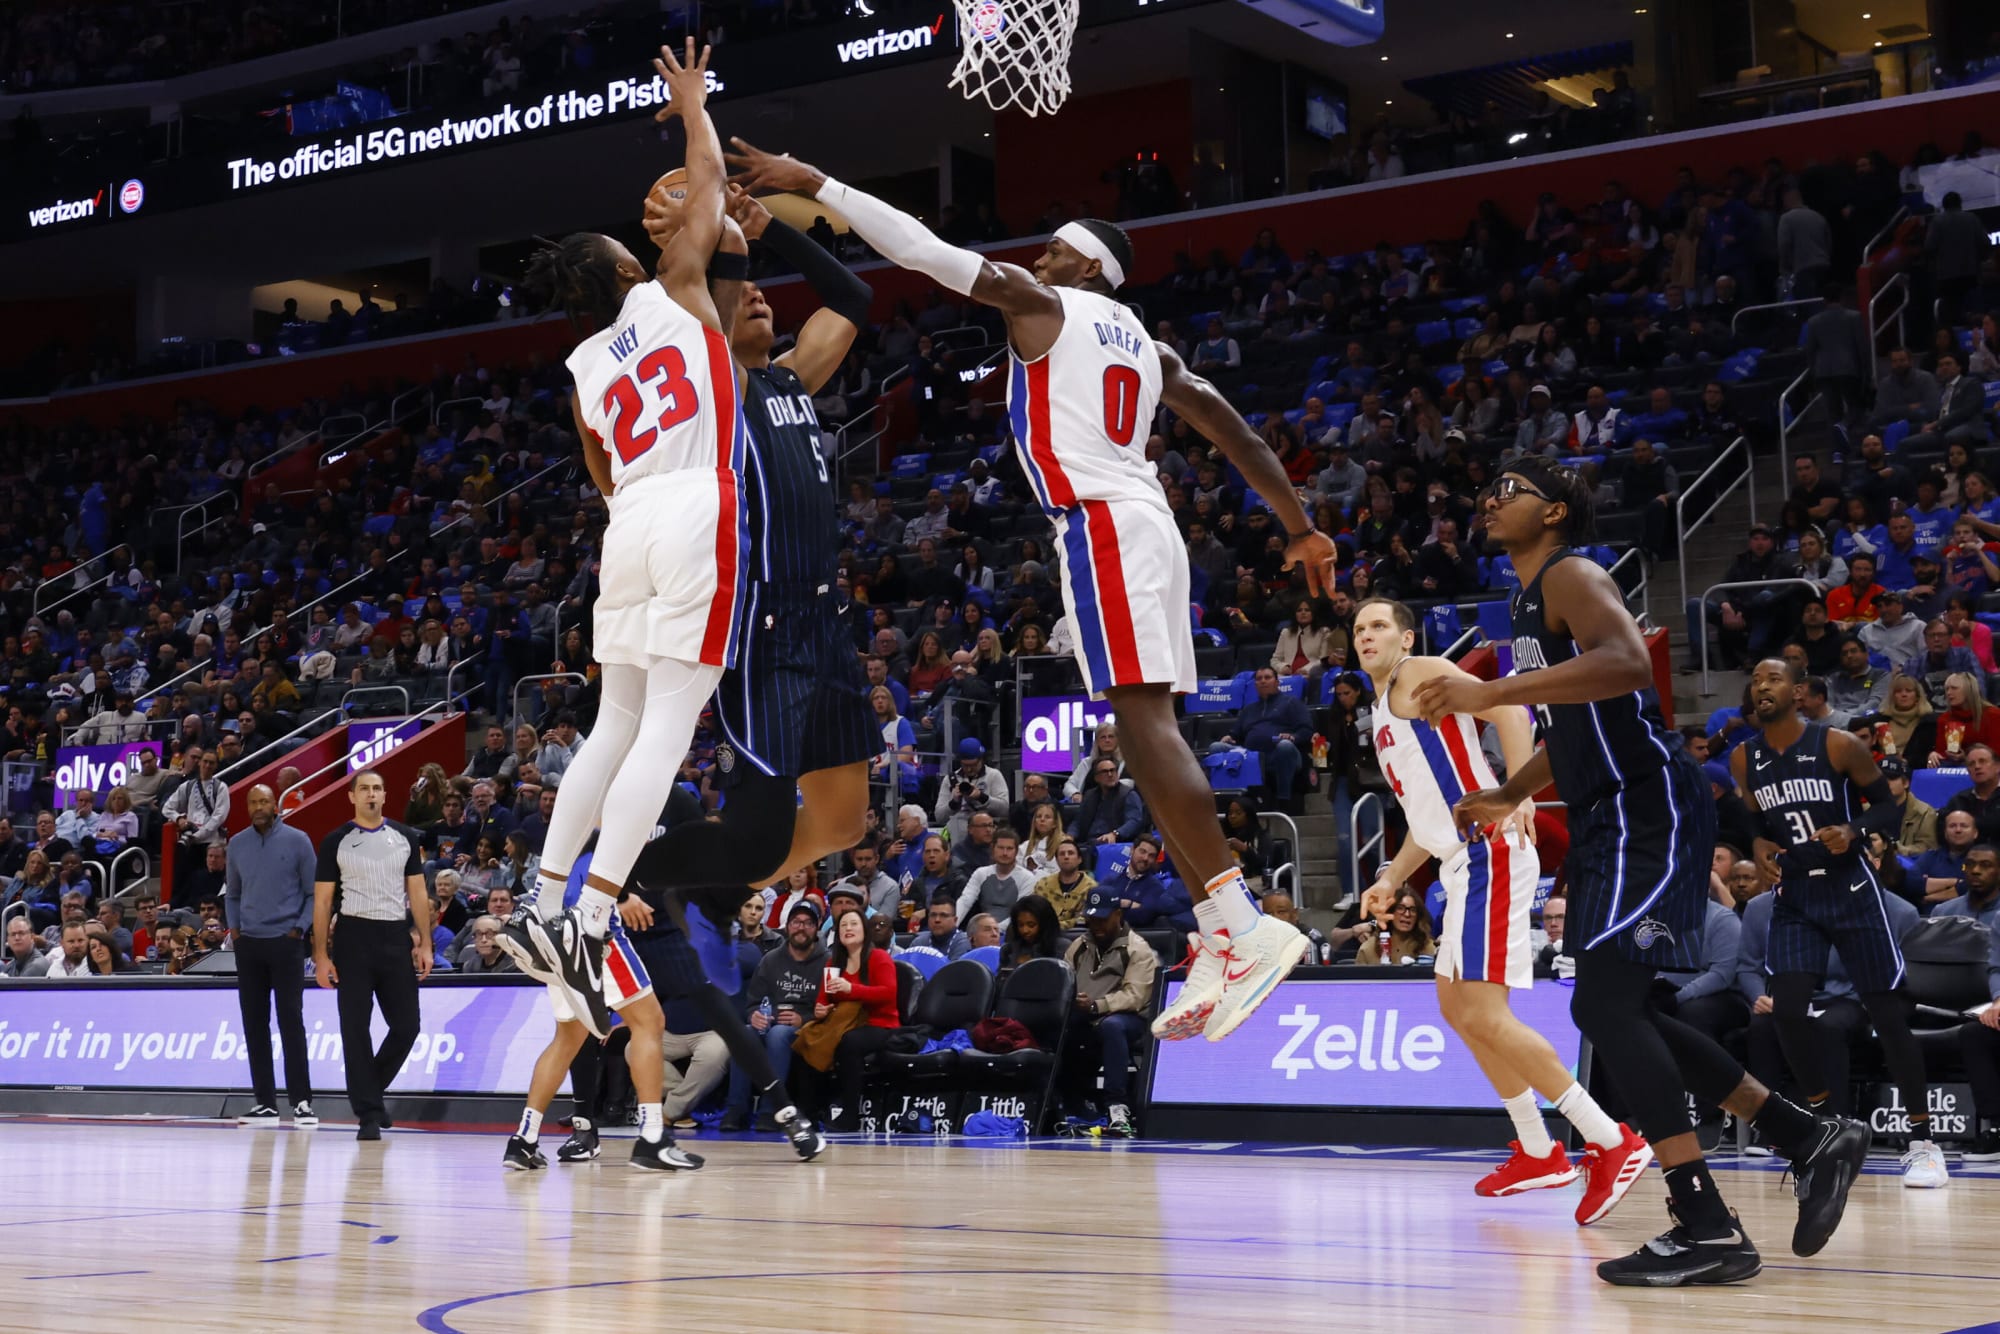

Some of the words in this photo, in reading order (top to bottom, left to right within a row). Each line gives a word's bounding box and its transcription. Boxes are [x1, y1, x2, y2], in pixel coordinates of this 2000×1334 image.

[837, 25, 932, 62] verizon
[227, 158, 275, 189] The
[278, 135, 362, 179] official
[366, 128, 405, 161] 5G
[409, 104, 521, 153] network
[524, 96, 552, 128] of
[557, 90, 604, 121] the
[28, 198, 95, 227] verizon
[608, 323, 640, 362] IVEY
[1094, 322, 1142, 359] DUREN
[603, 345, 698, 466] 23
[1102, 364, 1141, 446] 0
[810, 435, 829, 483] 5
[55, 755, 106, 792] ally
[1753, 778, 1834, 812] ORLANDO
[1785, 810, 1820, 845] 31
[44, 1020, 73, 1059] it
[77, 1020, 112, 1060] in
[114, 1031, 207, 1072] your
[1271, 1004, 1446, 1080] Zelle
